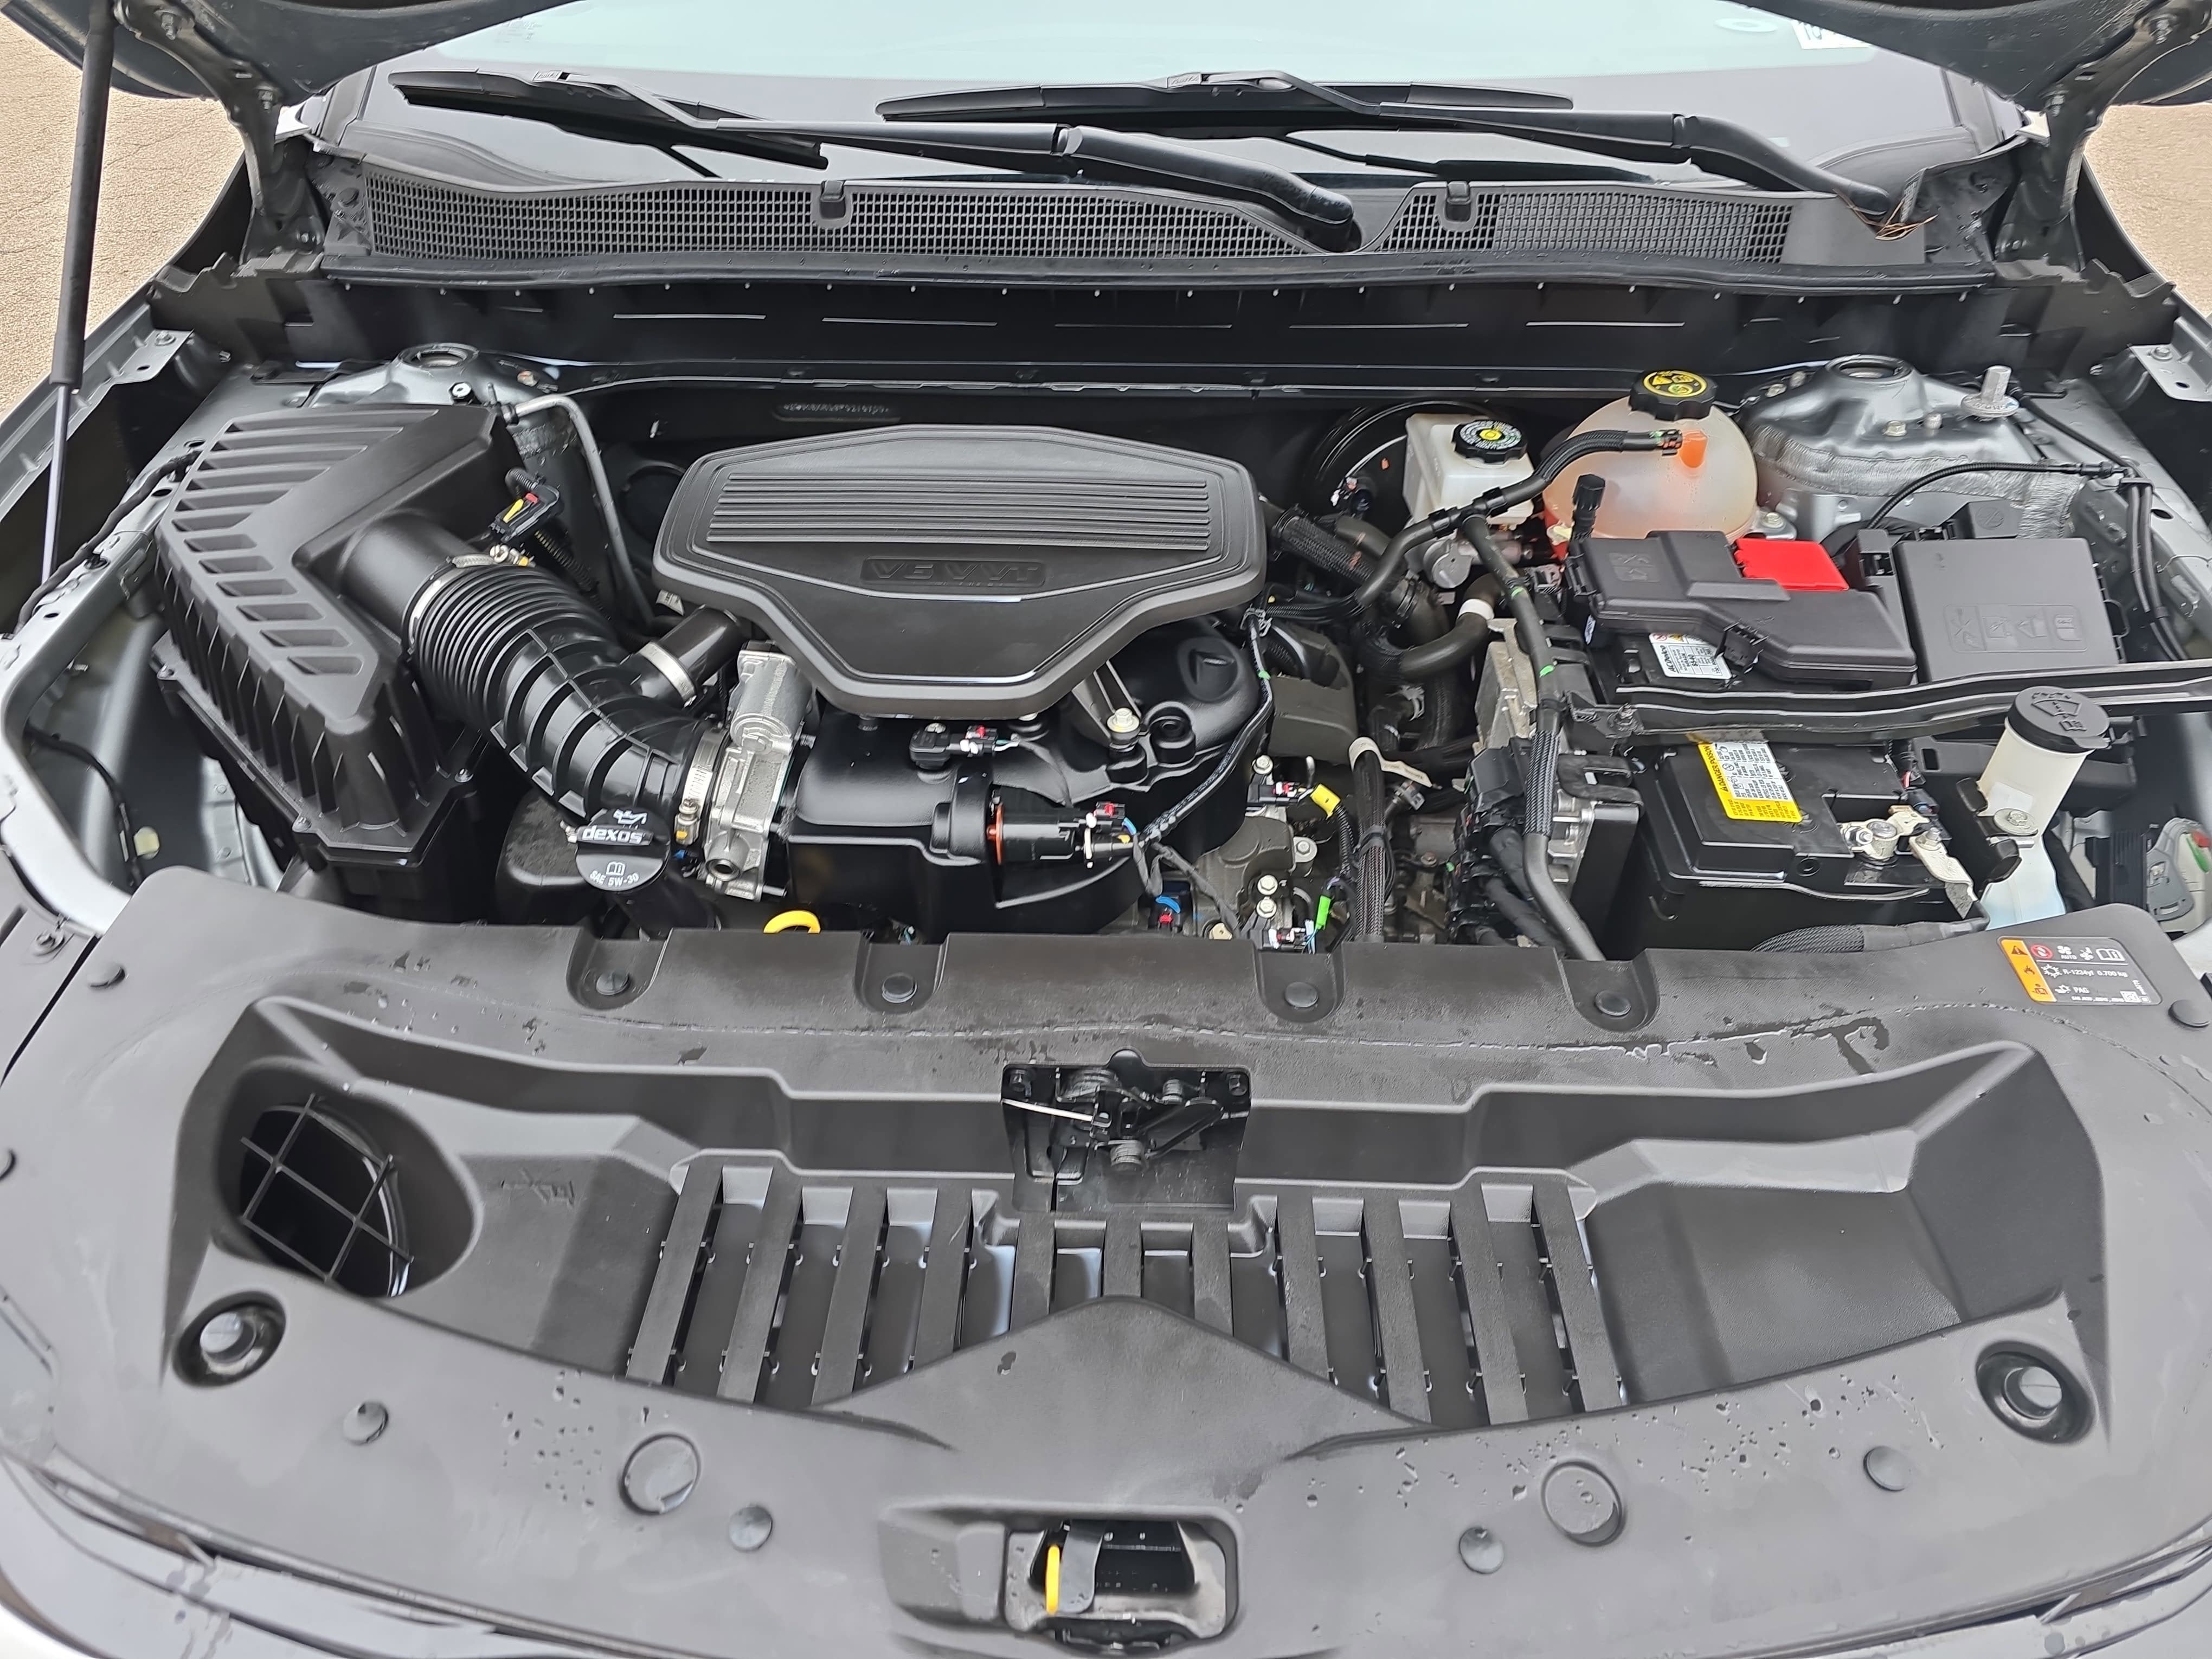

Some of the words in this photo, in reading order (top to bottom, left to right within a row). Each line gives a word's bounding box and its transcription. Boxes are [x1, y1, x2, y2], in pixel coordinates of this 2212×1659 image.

[871, 562, 935, 580] V6
[946, 563, 1039, 581] VVT
[1703, 745, 1718, 764] POISON
[1712, 764, 1726, 787] DANGER
[582, 825, 644, 844] dexos
[590, 870, 606, 885] SAE
[608, 872, 639, 887] 5W-30
